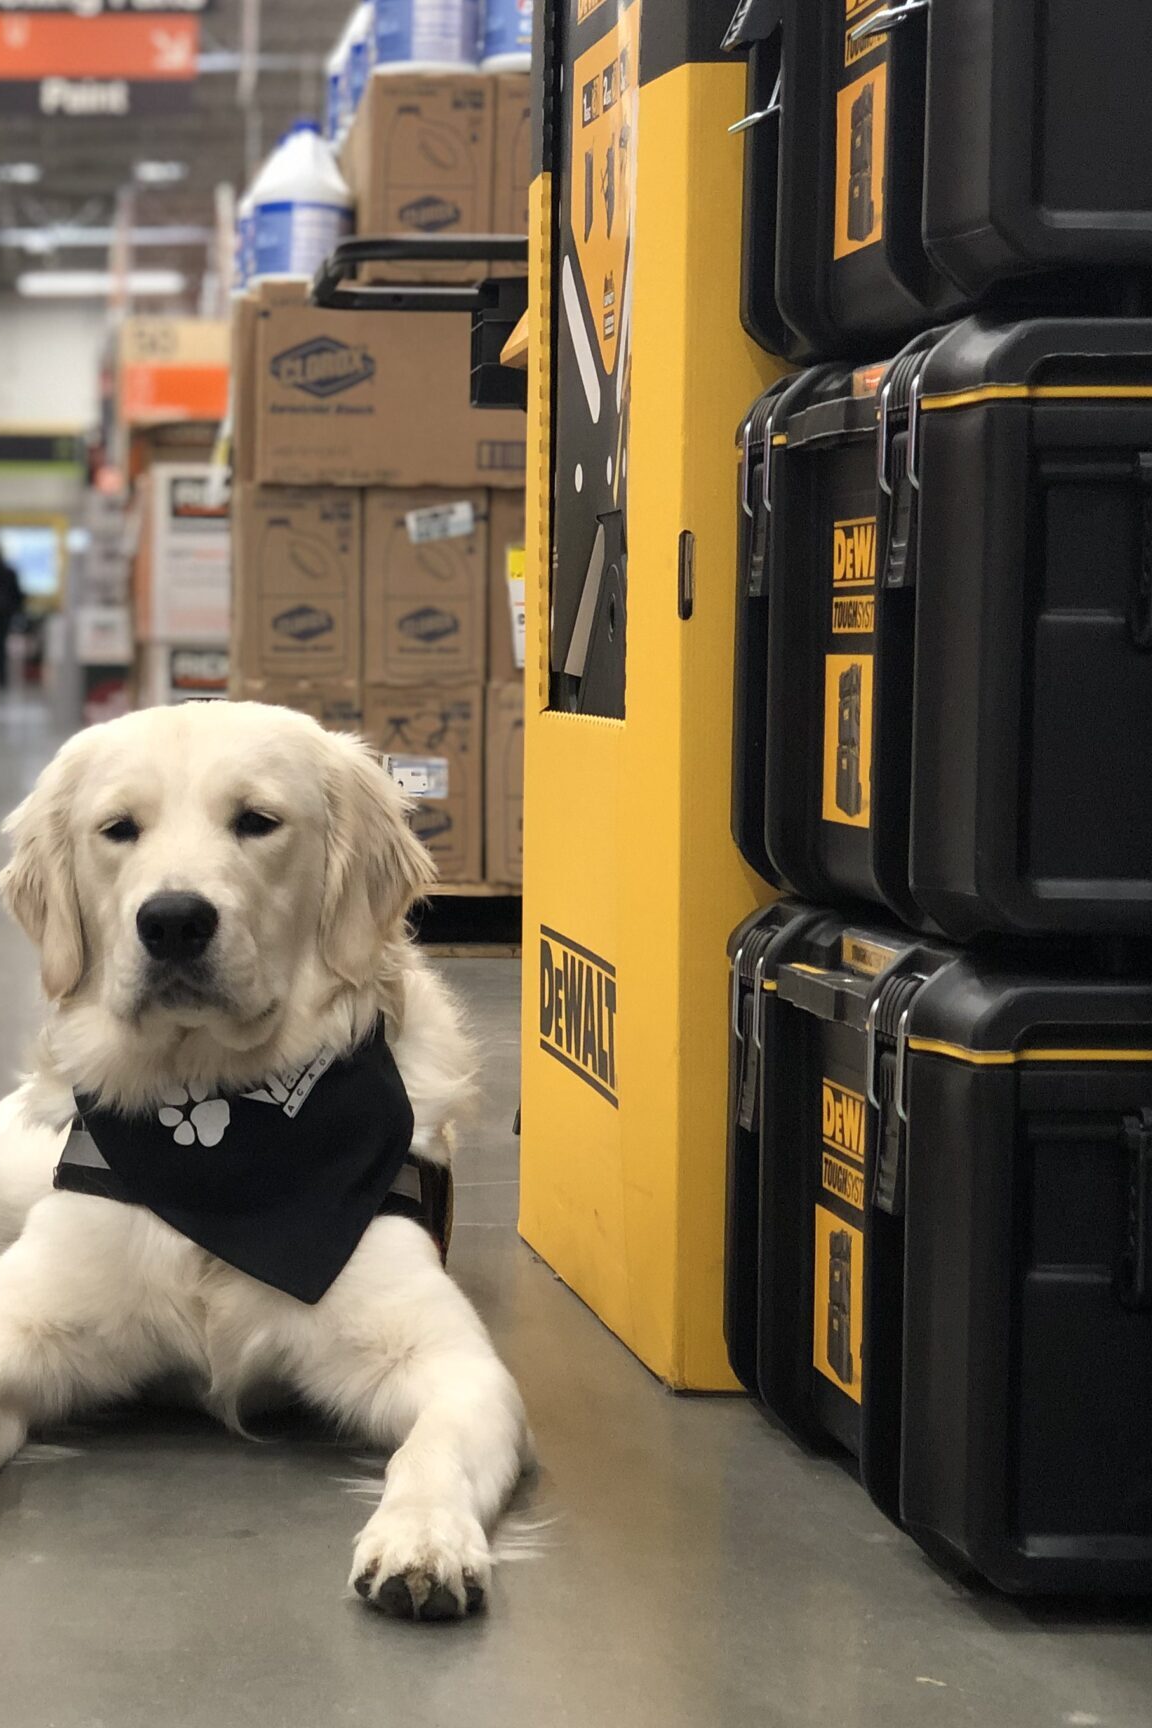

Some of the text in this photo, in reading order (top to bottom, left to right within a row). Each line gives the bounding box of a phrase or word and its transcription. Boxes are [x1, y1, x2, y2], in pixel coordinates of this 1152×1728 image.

[39, 76, 130, 115] Paint
[278, 346, 371, 388] CLOROX
[540, 937, 616, 1091] DEWALT
